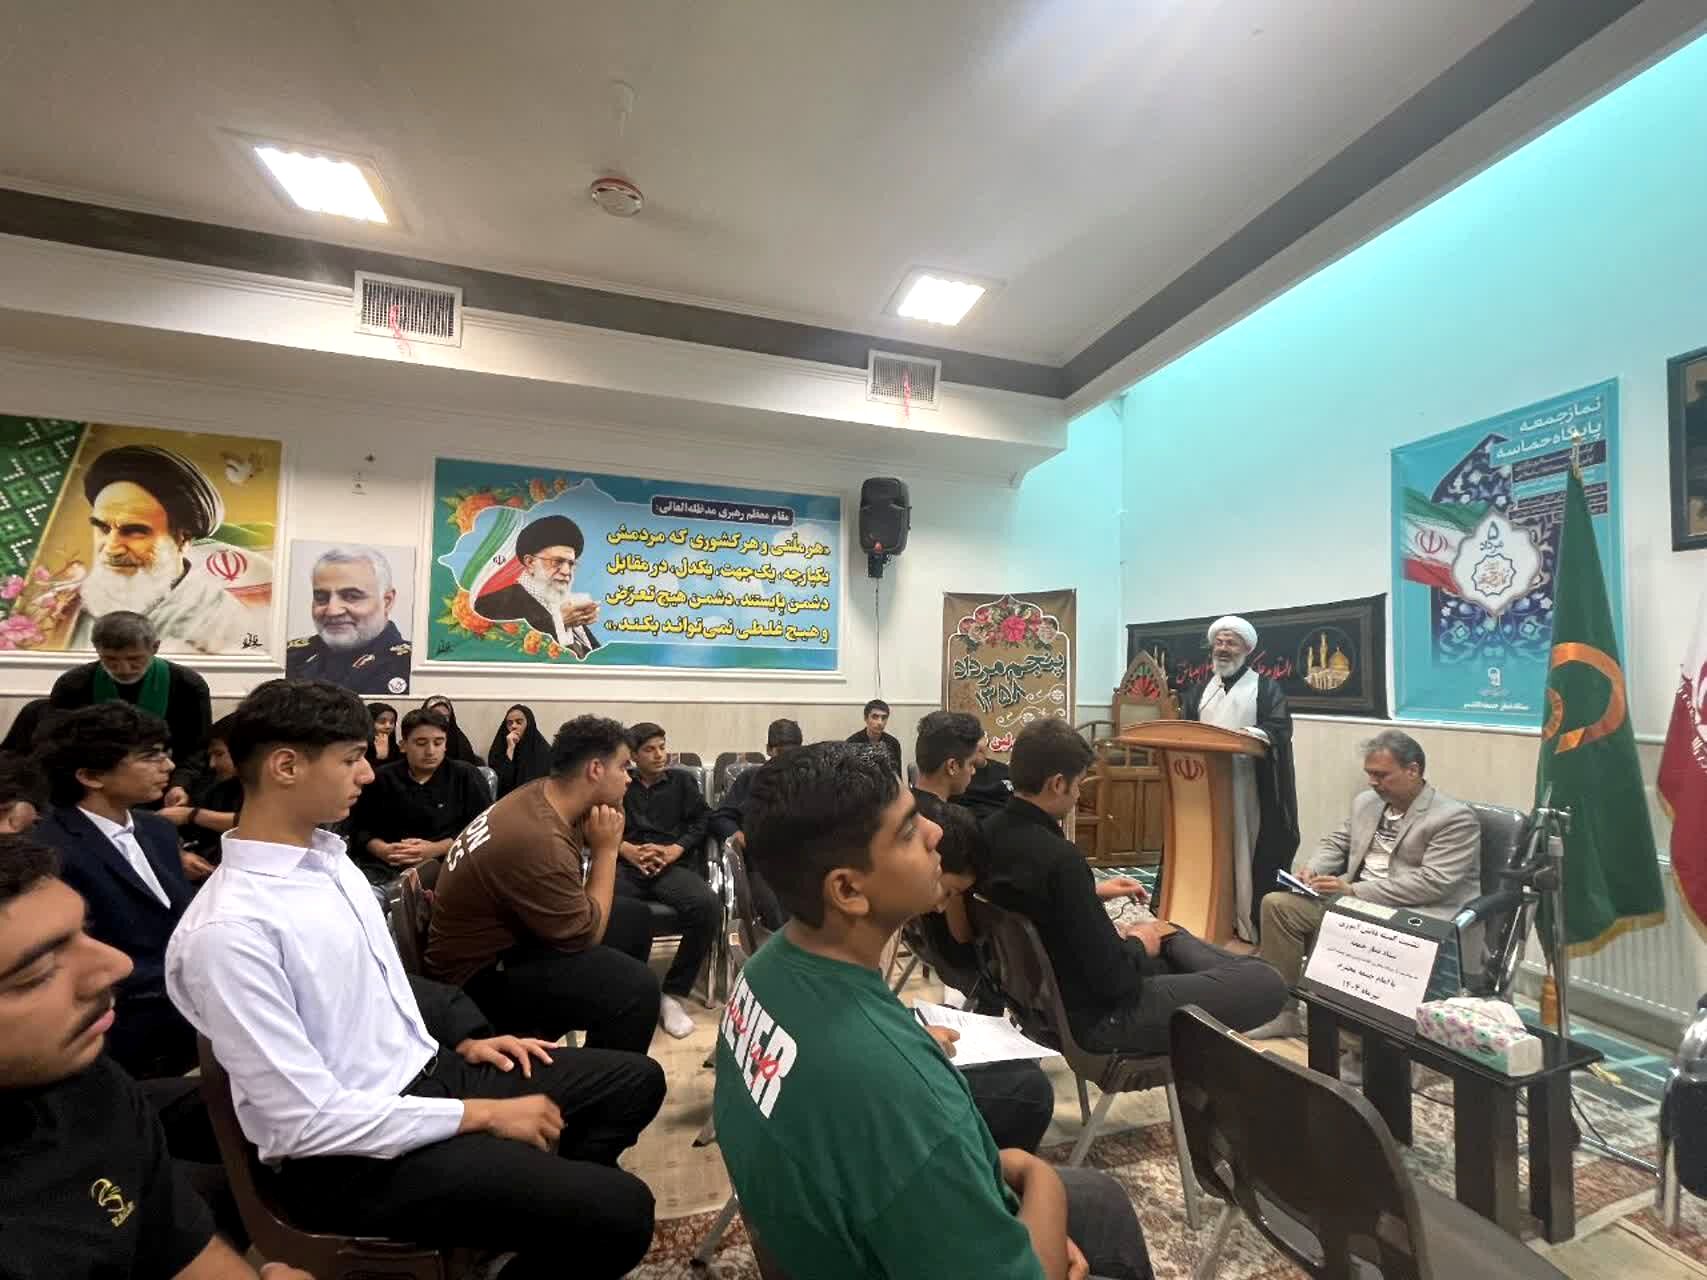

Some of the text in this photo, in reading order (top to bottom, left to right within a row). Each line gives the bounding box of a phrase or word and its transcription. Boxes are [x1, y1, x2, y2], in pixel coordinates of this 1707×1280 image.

[1520, 395, 1601, 432] نماز جمعه
[718, 507, 745, 520] رهبری
[746, 508, 770, 520] معظم
[771, 511, 790, 523] مقام
[606, 523, 666, 549] مردمش
[668, 527, 689, 544] که
[689, 532, 742, 552] کشوری
[739, 536, 760, 555] هر
[759, 541, 769, 555] و
[606, 553, 650, 575] مقابل
[648, 559, 669, 578] در
[656, 590, 688, 608] هیچ
[688, 588, 735, 609] دشمن
[787, 594, 831, 614] دشمن
[735, 618, 784, 640] غلطی
[784, 624, 820, 641] هیچ
[819, 628, 830, 643] و
[953, 652, 1065, 687] پنجم مرداد
